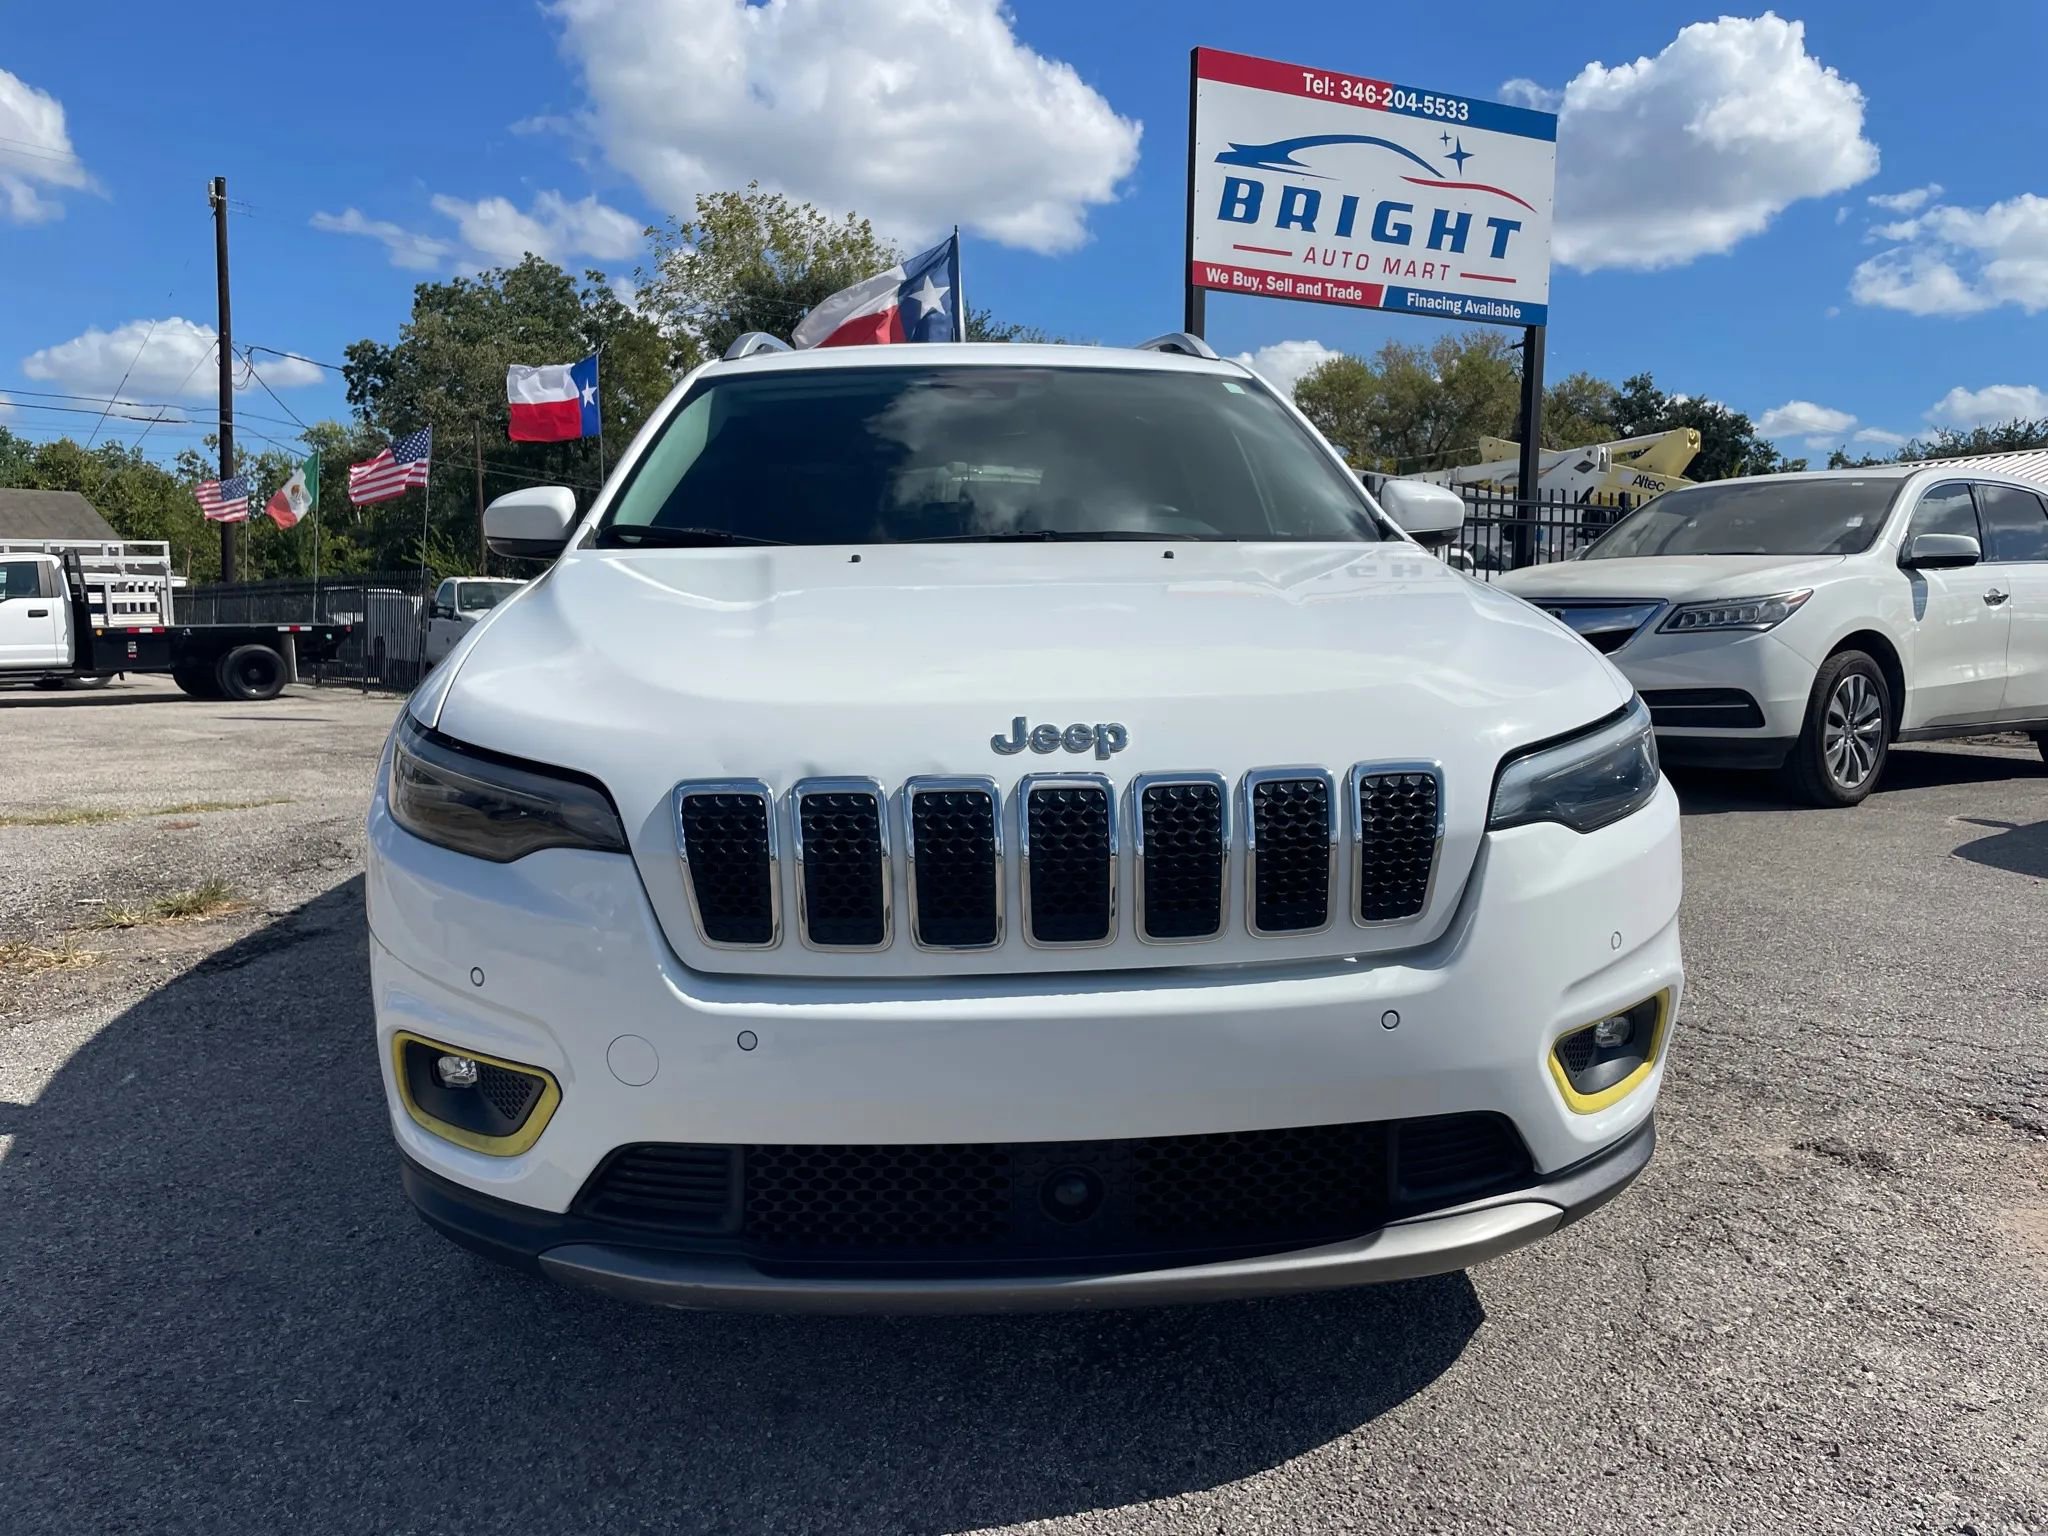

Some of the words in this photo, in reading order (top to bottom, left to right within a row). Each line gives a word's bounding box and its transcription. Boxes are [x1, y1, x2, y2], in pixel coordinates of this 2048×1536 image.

[1302, 73, 1335, 96] Tel:
[1341, 80, 1469, 121] 346-204-5533
[1217, 176, 1522, 259] BRIGHT
[1303, 247, 1370, 271] AUTO
[1382, 257, 1451, 281] MART
[1206, 268, 1229, 284] We
[1232, 272, 1263, 291] Buy,
[1266, 276, 1293, 293] Sell
[1296, 281, 1322, 296] and
[1325, 283, 1362, 300] Trade
[1407, 293, 1462, 314] Finacing
[1464, 300, 1521, 318] Available
[1632, 474, 1665, 492] Altec
[990, 716, 1129, 761] Jeep
